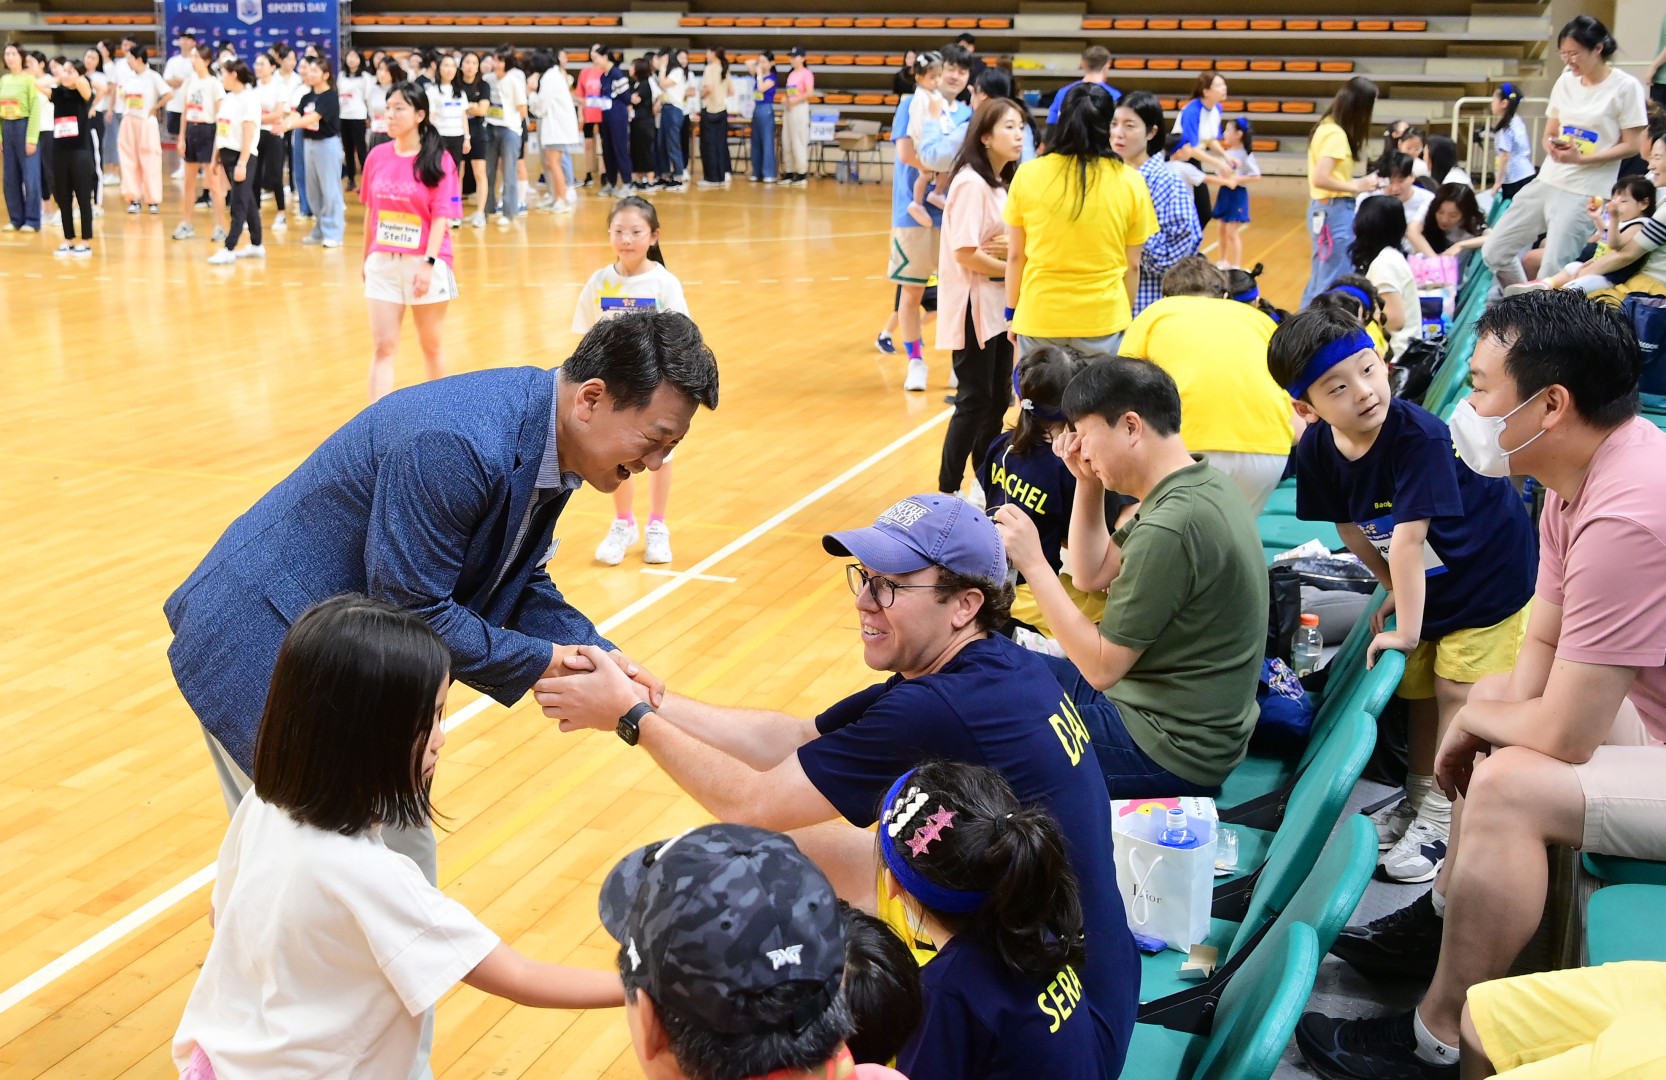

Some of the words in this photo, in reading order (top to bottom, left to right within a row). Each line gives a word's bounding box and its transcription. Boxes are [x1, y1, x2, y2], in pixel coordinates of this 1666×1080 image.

[266, 2, 306, 13] SPORTS
[307, 1, 328, 12] DAY
[383, 231, 412, 243] Stella
